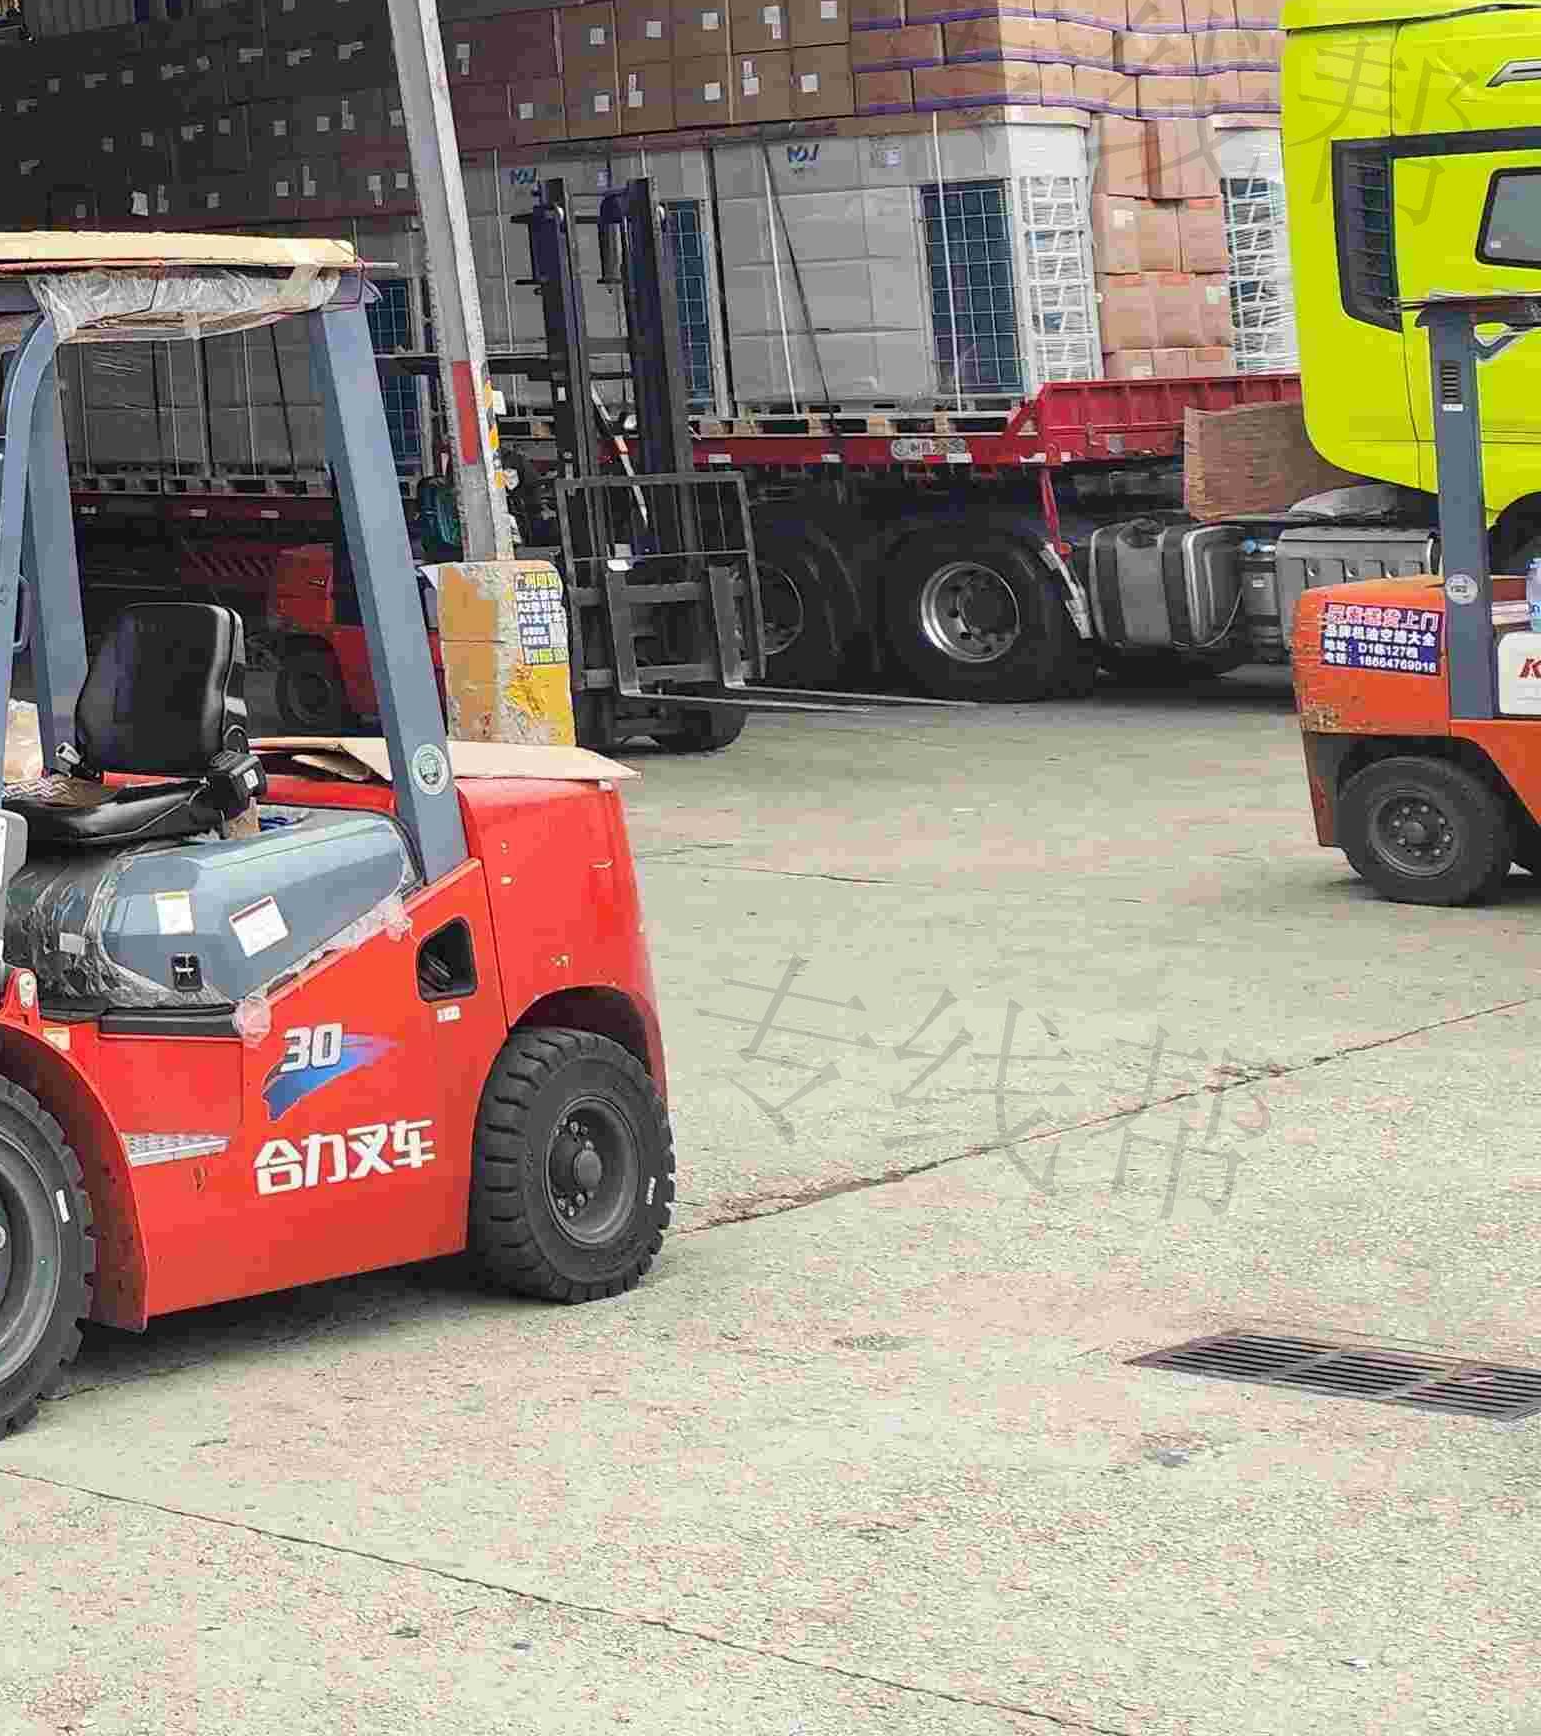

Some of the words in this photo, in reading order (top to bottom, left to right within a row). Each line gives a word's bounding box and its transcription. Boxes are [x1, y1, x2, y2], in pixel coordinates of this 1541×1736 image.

[280, 1023, 342, 1072] 30
[253, 1119, 437, 1195] 合力叉车
